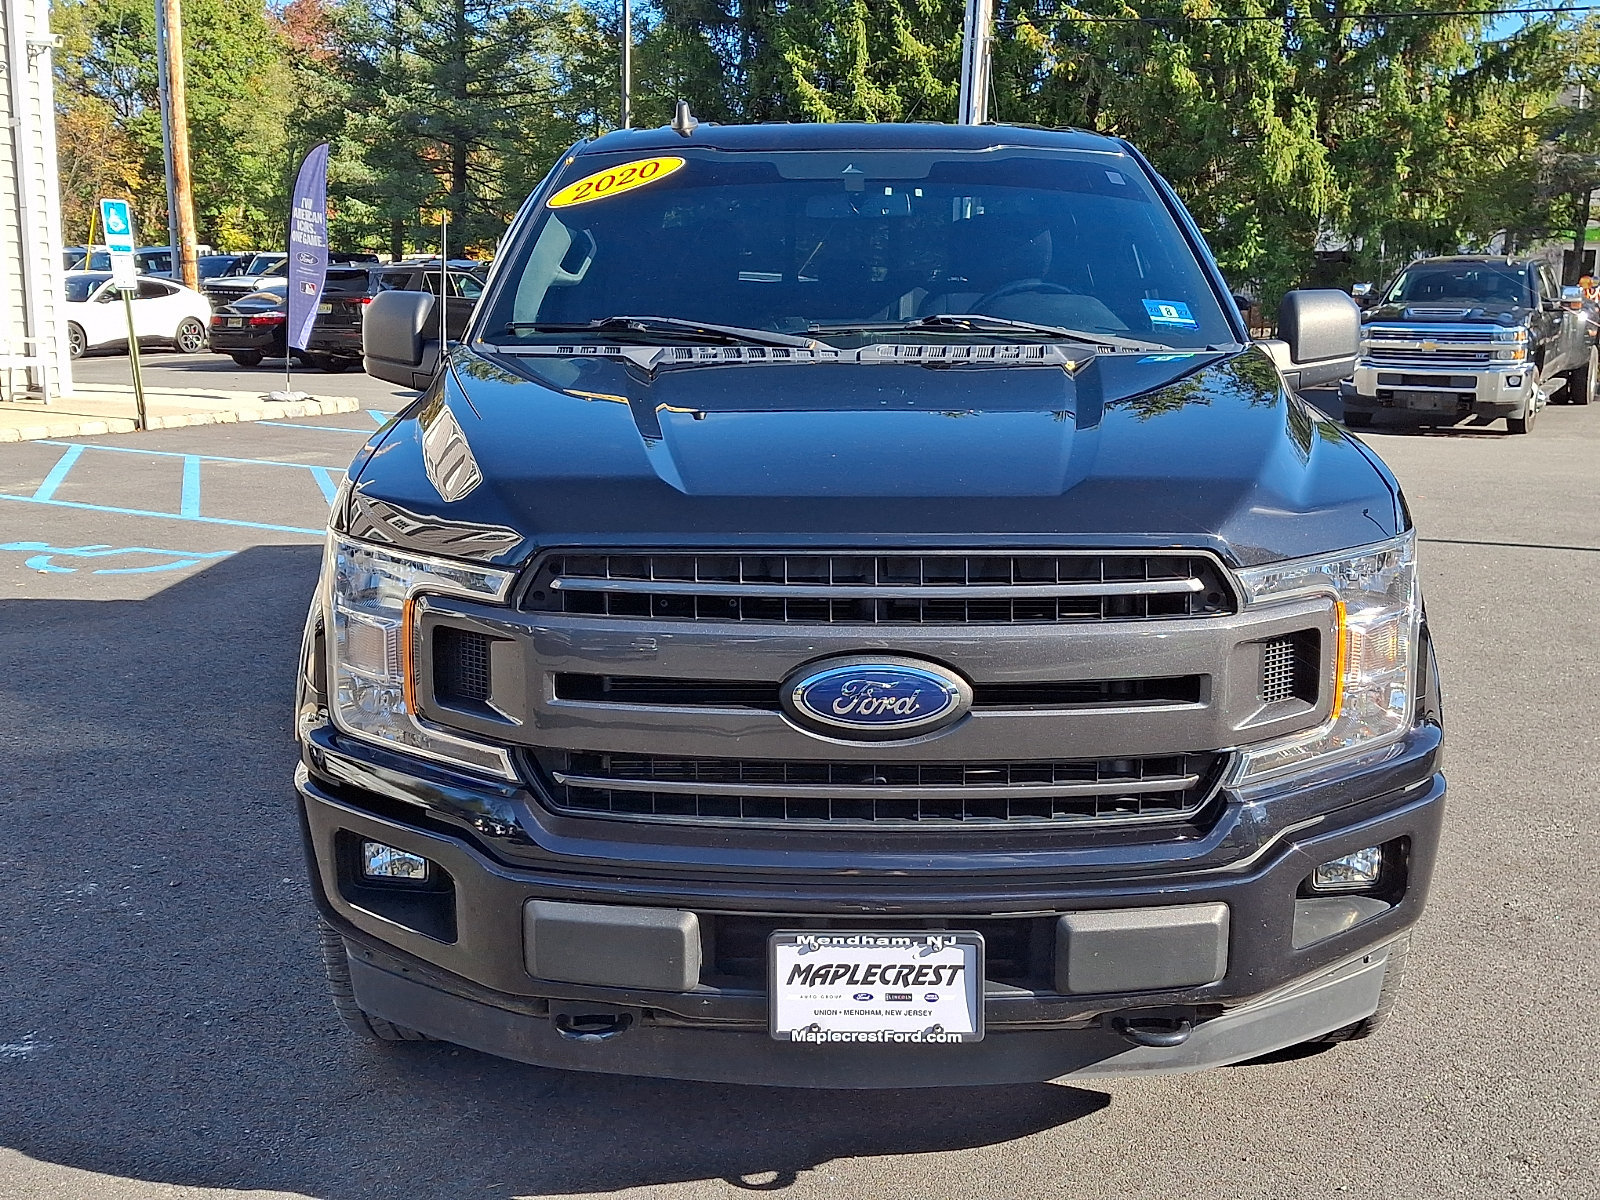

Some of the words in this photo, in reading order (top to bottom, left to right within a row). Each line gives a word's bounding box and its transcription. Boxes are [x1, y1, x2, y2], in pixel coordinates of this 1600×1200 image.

[572, 161, 660, 201] 2020
[1164, 306, 1173, 317] 8
[832, 679, 921, 716] Ford
[796, 935, 919, 947] Mendham,
[926, 935, 957, 947] NJ
[786, 963, 965, 988] MAPLECREST
[887, 993, 912, 1001] LINCOLN
[843, 1009, 884, 1017] MENDHAM,
[904, 1009, 933, 1017] JERSEY
[791, 1028, 963, 1044] MaplecrestFord.com
